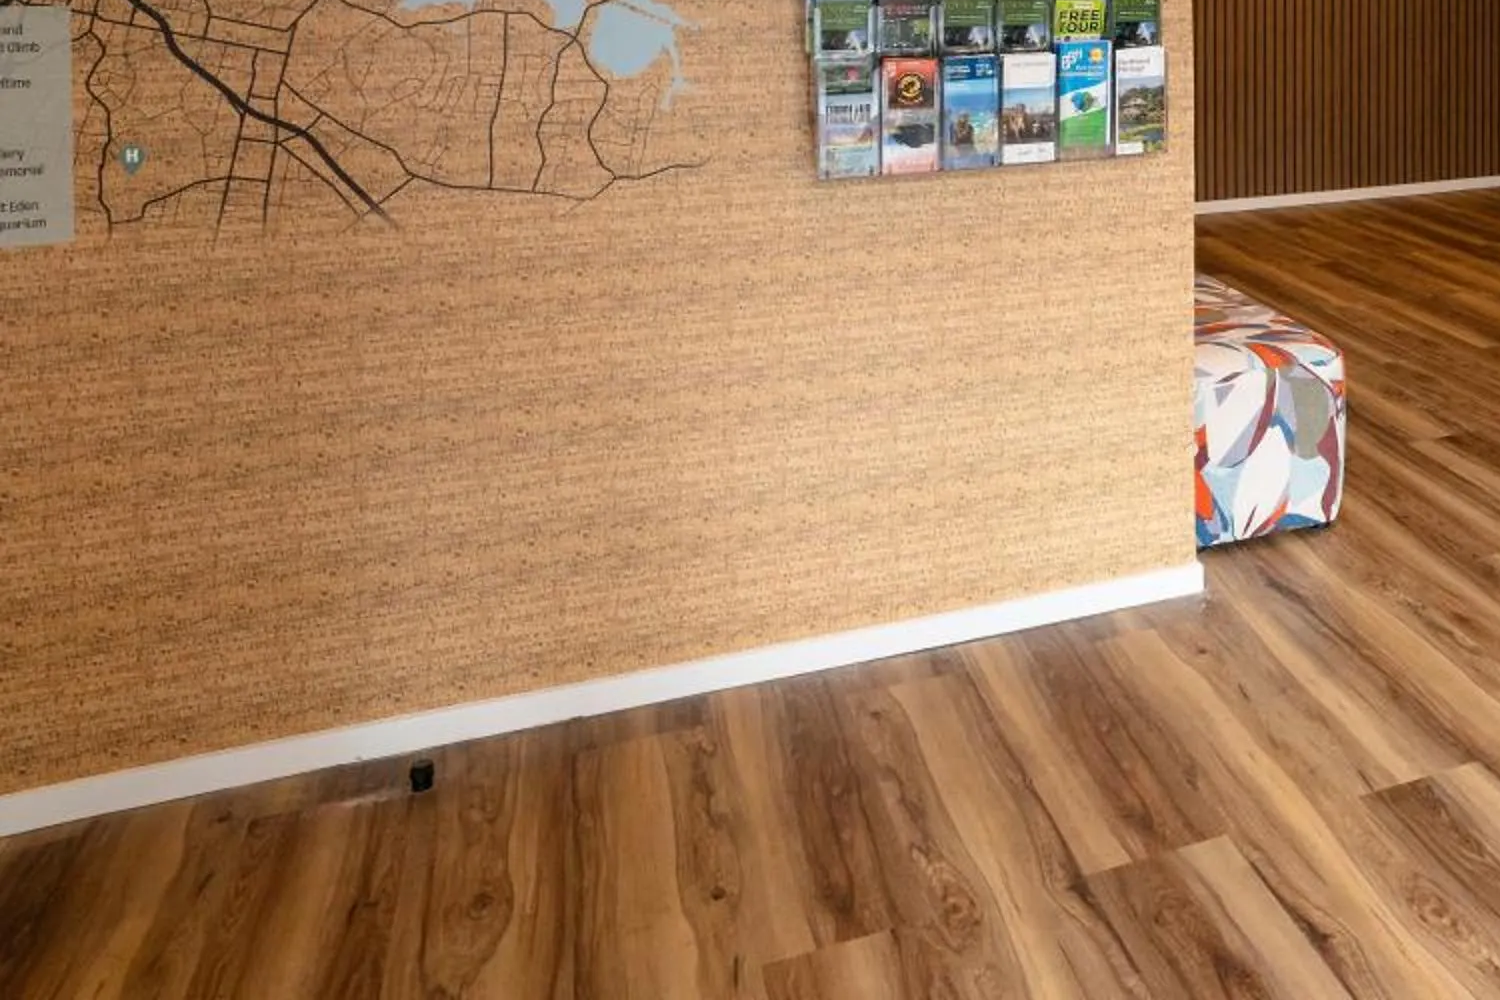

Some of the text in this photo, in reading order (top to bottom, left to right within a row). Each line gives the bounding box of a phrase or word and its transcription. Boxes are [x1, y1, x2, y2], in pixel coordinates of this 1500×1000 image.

[1059, 9, 1101, 21] FREE
[1059, 21, 1100, 33] TOUR
[125, 148, 139, 163] H
